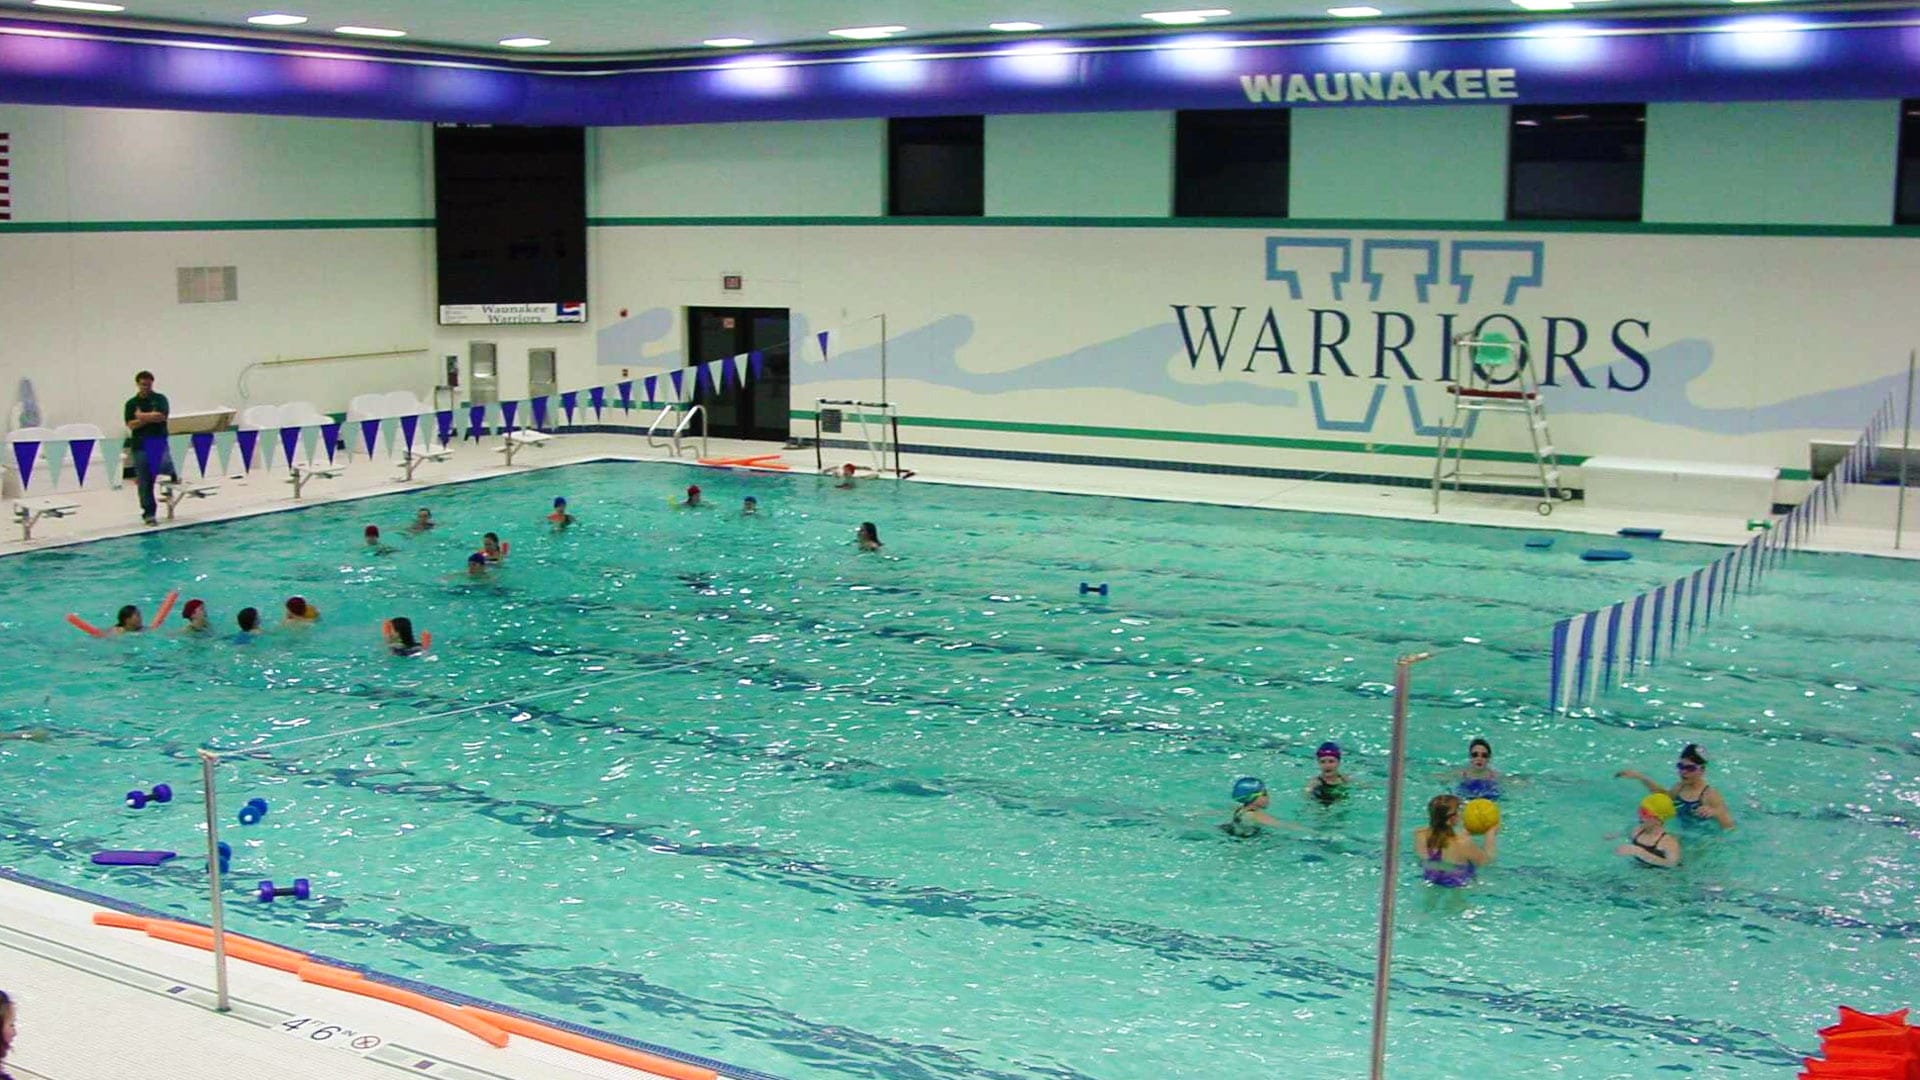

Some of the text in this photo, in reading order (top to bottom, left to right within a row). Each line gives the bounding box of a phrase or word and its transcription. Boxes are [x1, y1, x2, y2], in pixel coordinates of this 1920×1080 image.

[1240, 68, 1519, 103] WAUNAKEE
[482, 304, 548, 313] Waunakee
[487, 314, 542, 323] Warriors
[1169, 304, 1652, 392] WARRIORS
